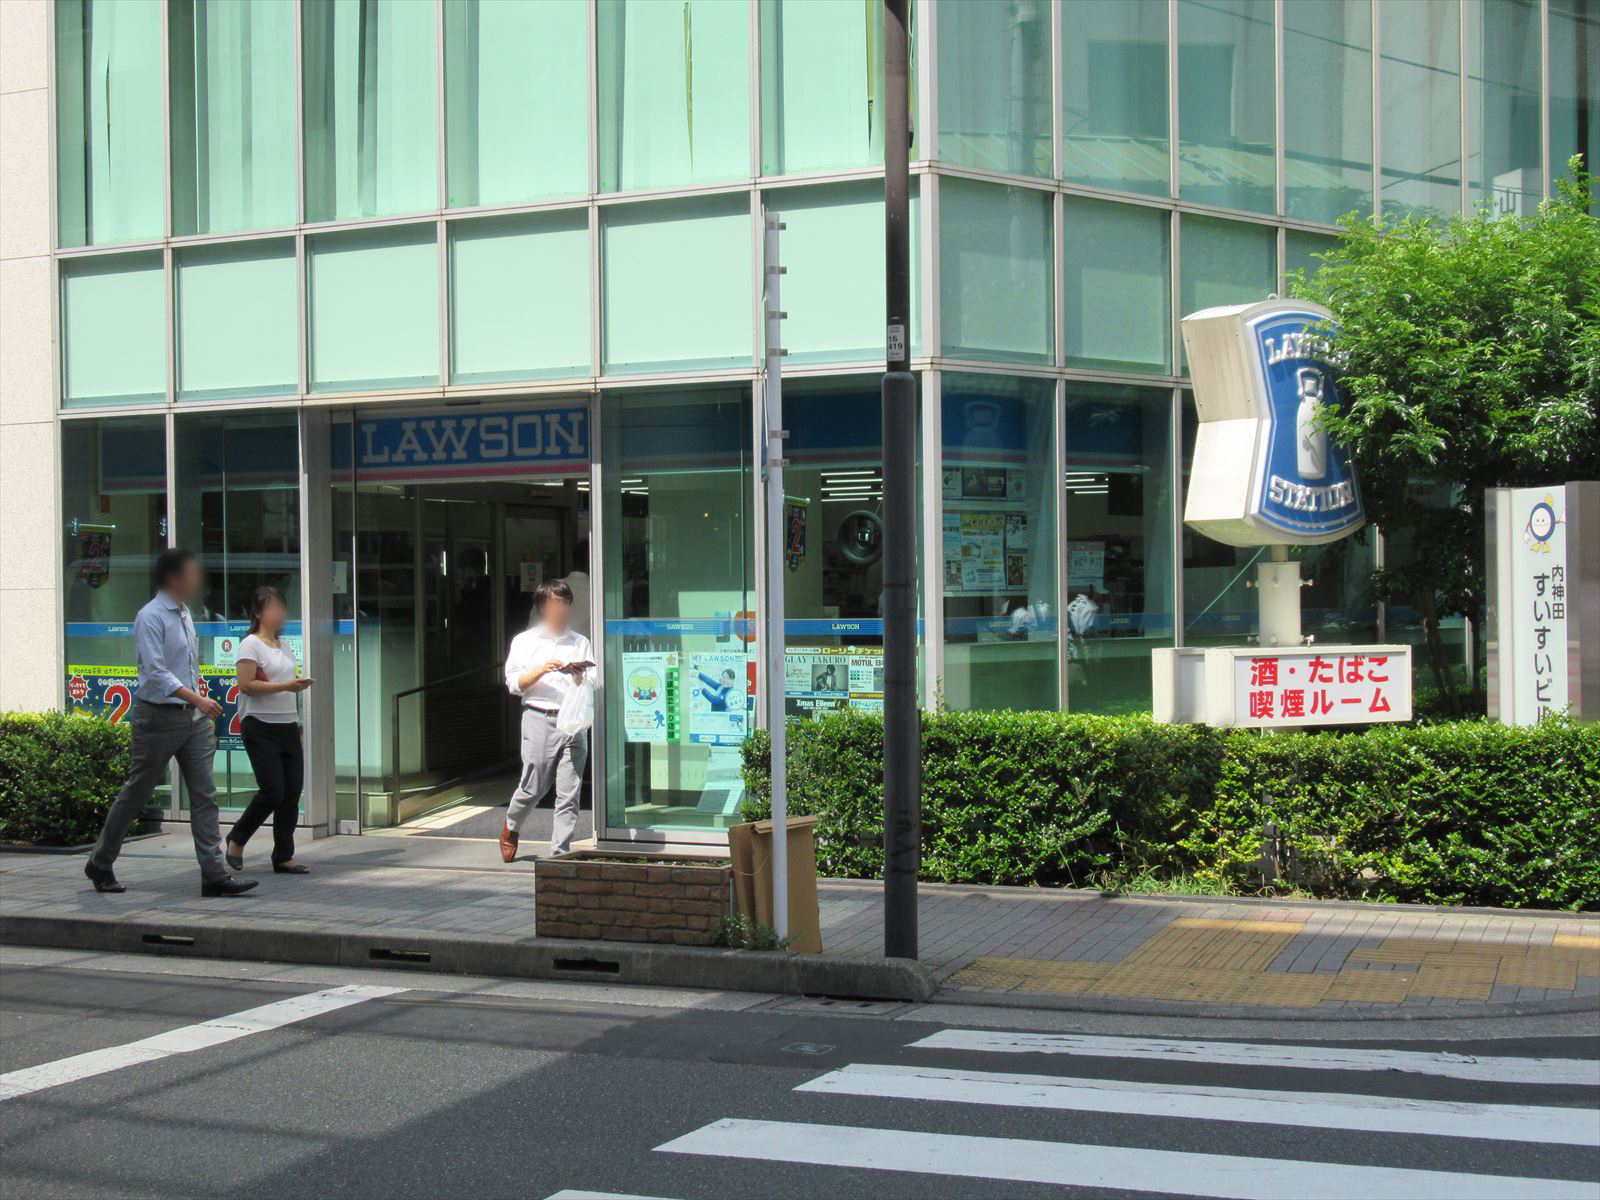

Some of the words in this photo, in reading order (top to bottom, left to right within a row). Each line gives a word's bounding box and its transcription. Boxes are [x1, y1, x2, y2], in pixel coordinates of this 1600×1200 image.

[361, 412, 585, 463] LAWSON
[1551, 565, 1565, 620] 内神田
[784, 656, 808, 664] GLAY
[811, 655, 846, 664] TAKURO
[851, 659, 873, 667] MOTUL
[1249, 656, 1390, 687] 酒・たばこ
[796, 699, 814, 707] Xmas
[816, 699, 836, 707] Eileen
[1249, 687, 1392, 720] 喫煙ルーム
